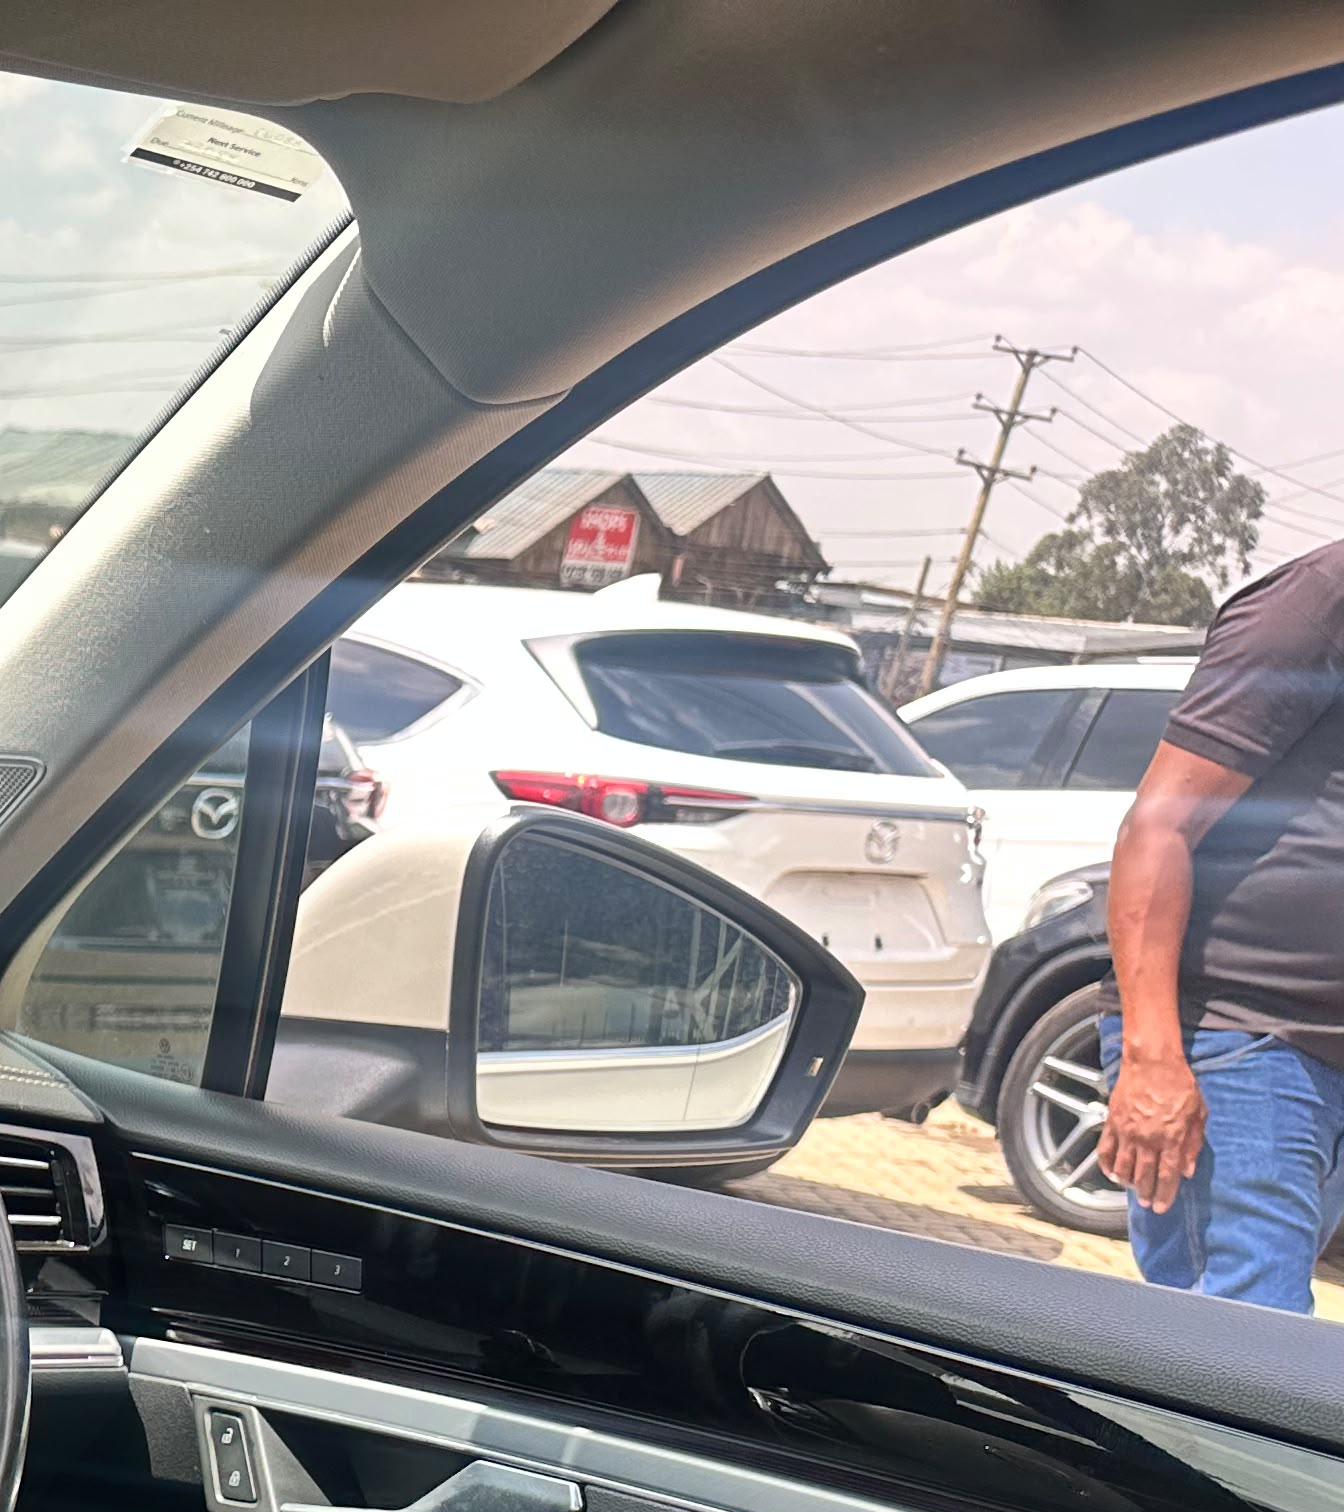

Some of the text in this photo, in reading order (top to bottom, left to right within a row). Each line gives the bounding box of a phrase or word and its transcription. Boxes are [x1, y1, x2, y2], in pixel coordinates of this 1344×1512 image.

[208, 137, 228, 149] Next
[230, 142, 261, 157] Service
[284, 1256, 291, 1266] 2
[334, 1264, 342, 1276] 3
